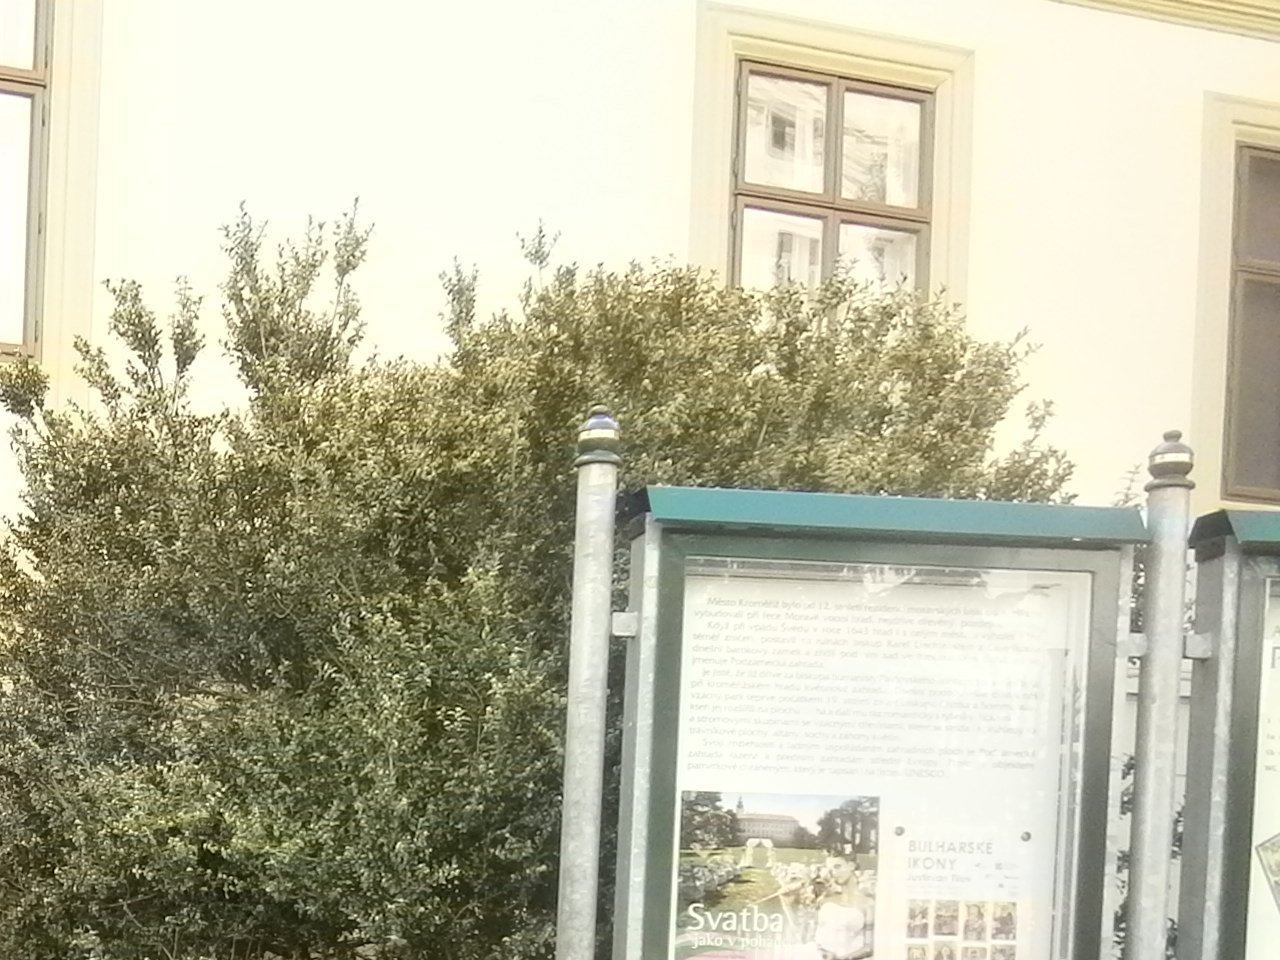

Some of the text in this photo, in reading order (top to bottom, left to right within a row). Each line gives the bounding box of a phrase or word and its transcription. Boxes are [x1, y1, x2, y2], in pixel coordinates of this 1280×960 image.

[907, 857, 957, 870] IKONY
[687, 903, 783, 932] Svatba
[692, 932, 723, 949] jako
[728, 937, 738, 946] v
